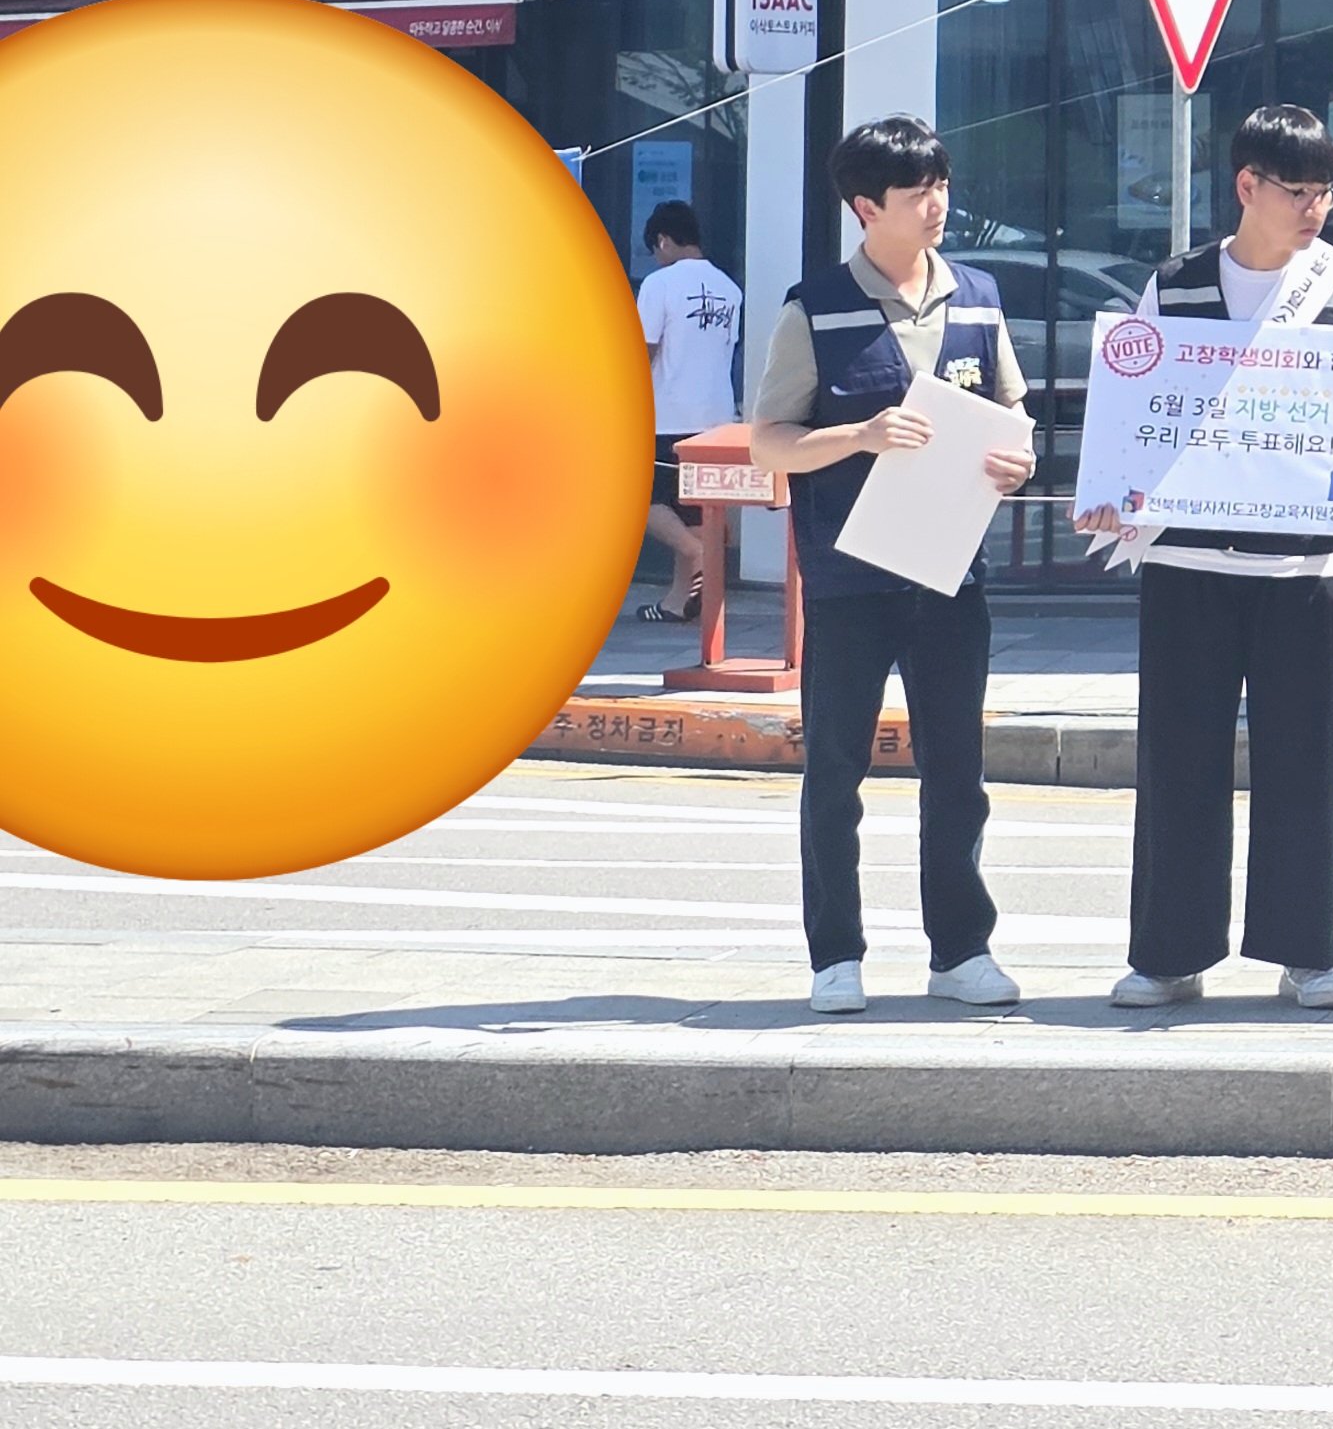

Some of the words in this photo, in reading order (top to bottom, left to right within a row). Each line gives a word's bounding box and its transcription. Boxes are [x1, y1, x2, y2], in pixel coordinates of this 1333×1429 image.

[1110, 336, 1154, 360] VOTE
[1175, 344, 1322, 370] 고창학생의회와
[1149, 394, 1184, 417] 6월
[1192, 395, 1228, 419] 3일
[1235, 398, 1280, 421] 지방
[1288, 400, 1330, 424] 선거
[1136, 425, 1178, 448] 우리
[1186, 428, 1231, 451] 모두
